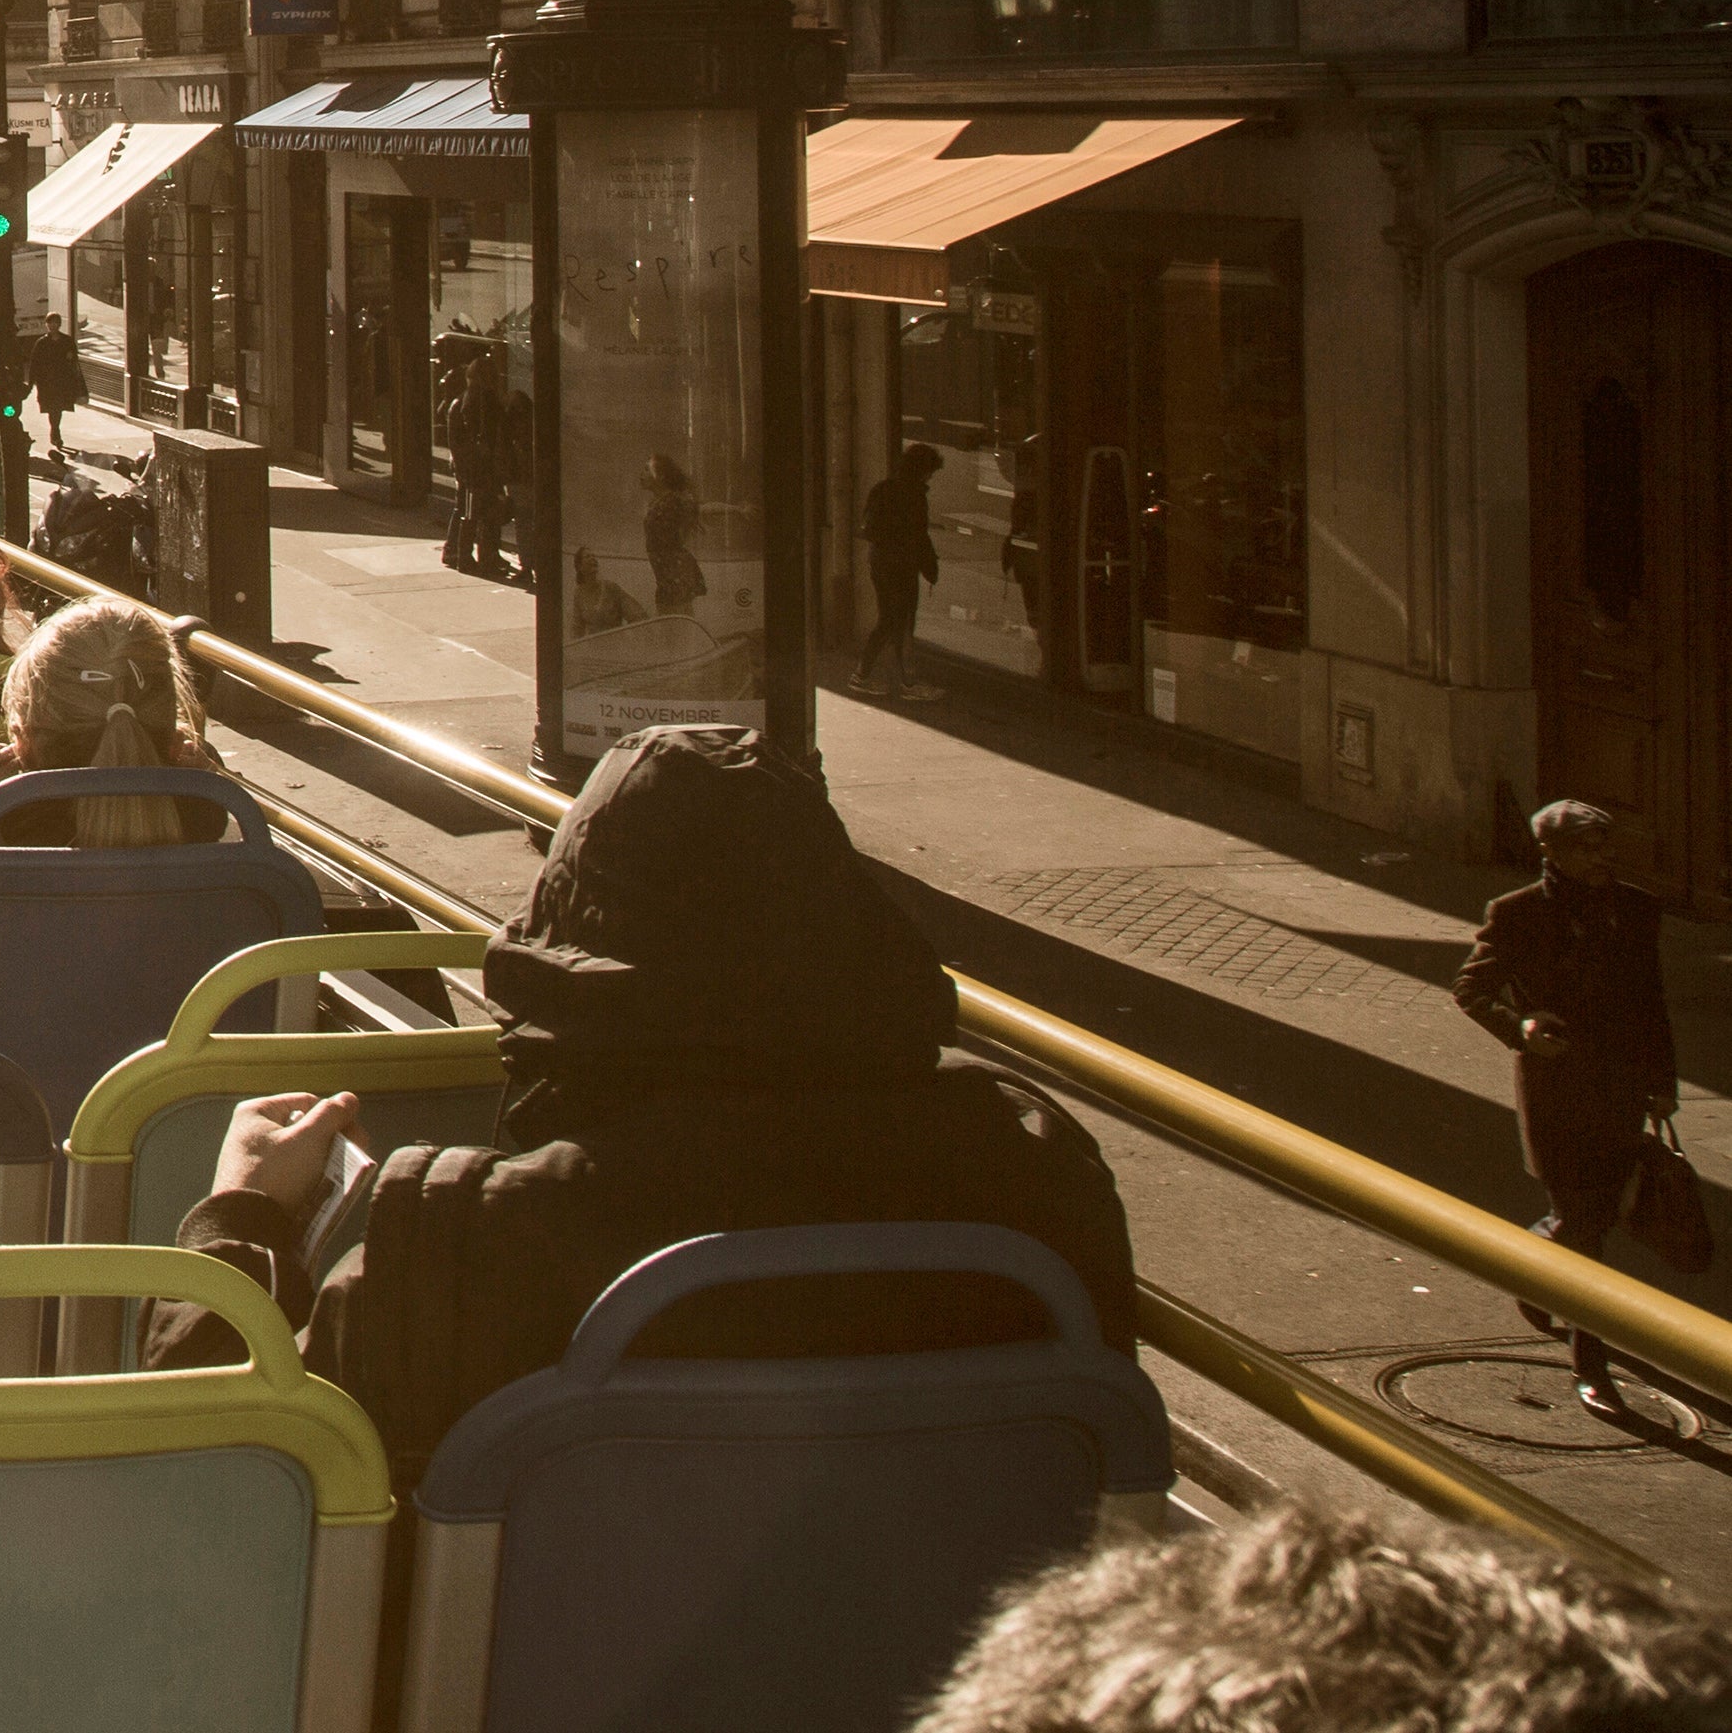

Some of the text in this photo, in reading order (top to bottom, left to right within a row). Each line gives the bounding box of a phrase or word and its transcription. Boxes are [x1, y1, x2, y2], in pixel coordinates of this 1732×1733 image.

[271, 10, 331, 20] SYPHAX
[9, 118, 50, 128] KUSMI TEA
[599, 704, 722, 724] 12 NOVEMBRE
